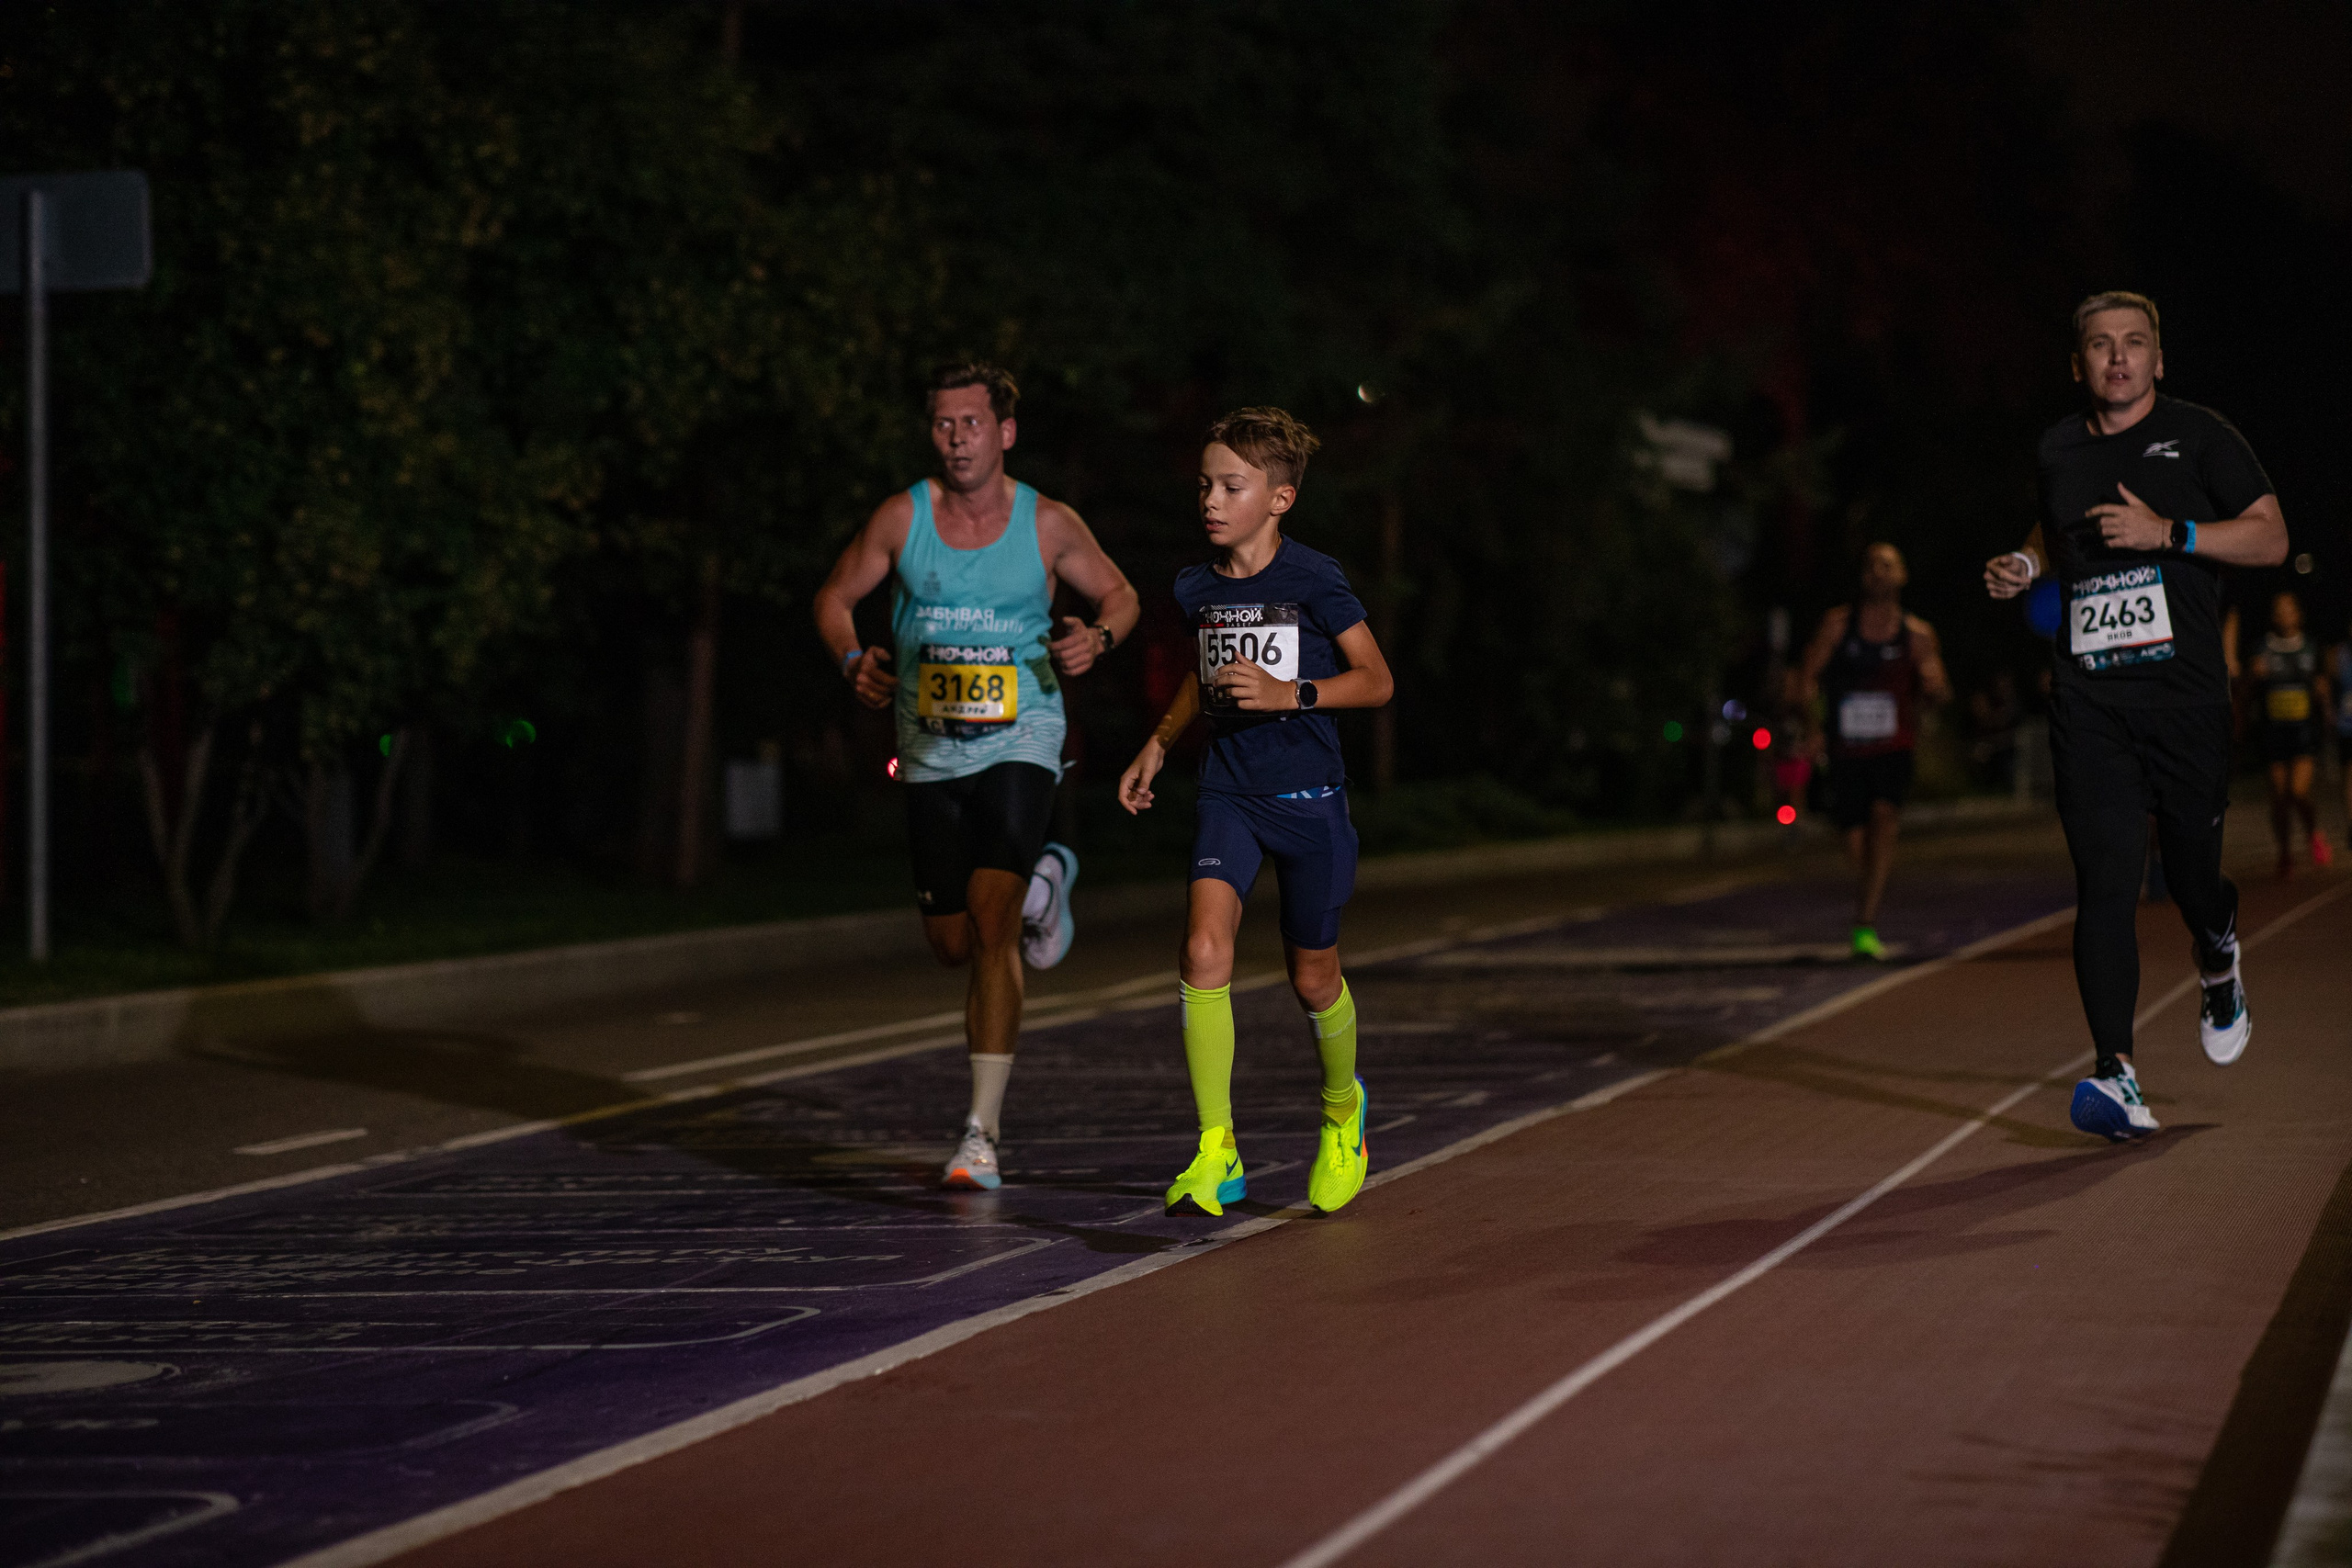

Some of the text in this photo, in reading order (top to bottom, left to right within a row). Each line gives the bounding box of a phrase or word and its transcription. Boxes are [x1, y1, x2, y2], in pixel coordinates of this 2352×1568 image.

[2080, 596, 2154, 634] 2463
[1207, 632, 1283, 667] 5506
[931, 672, 1005, 703] 3168
